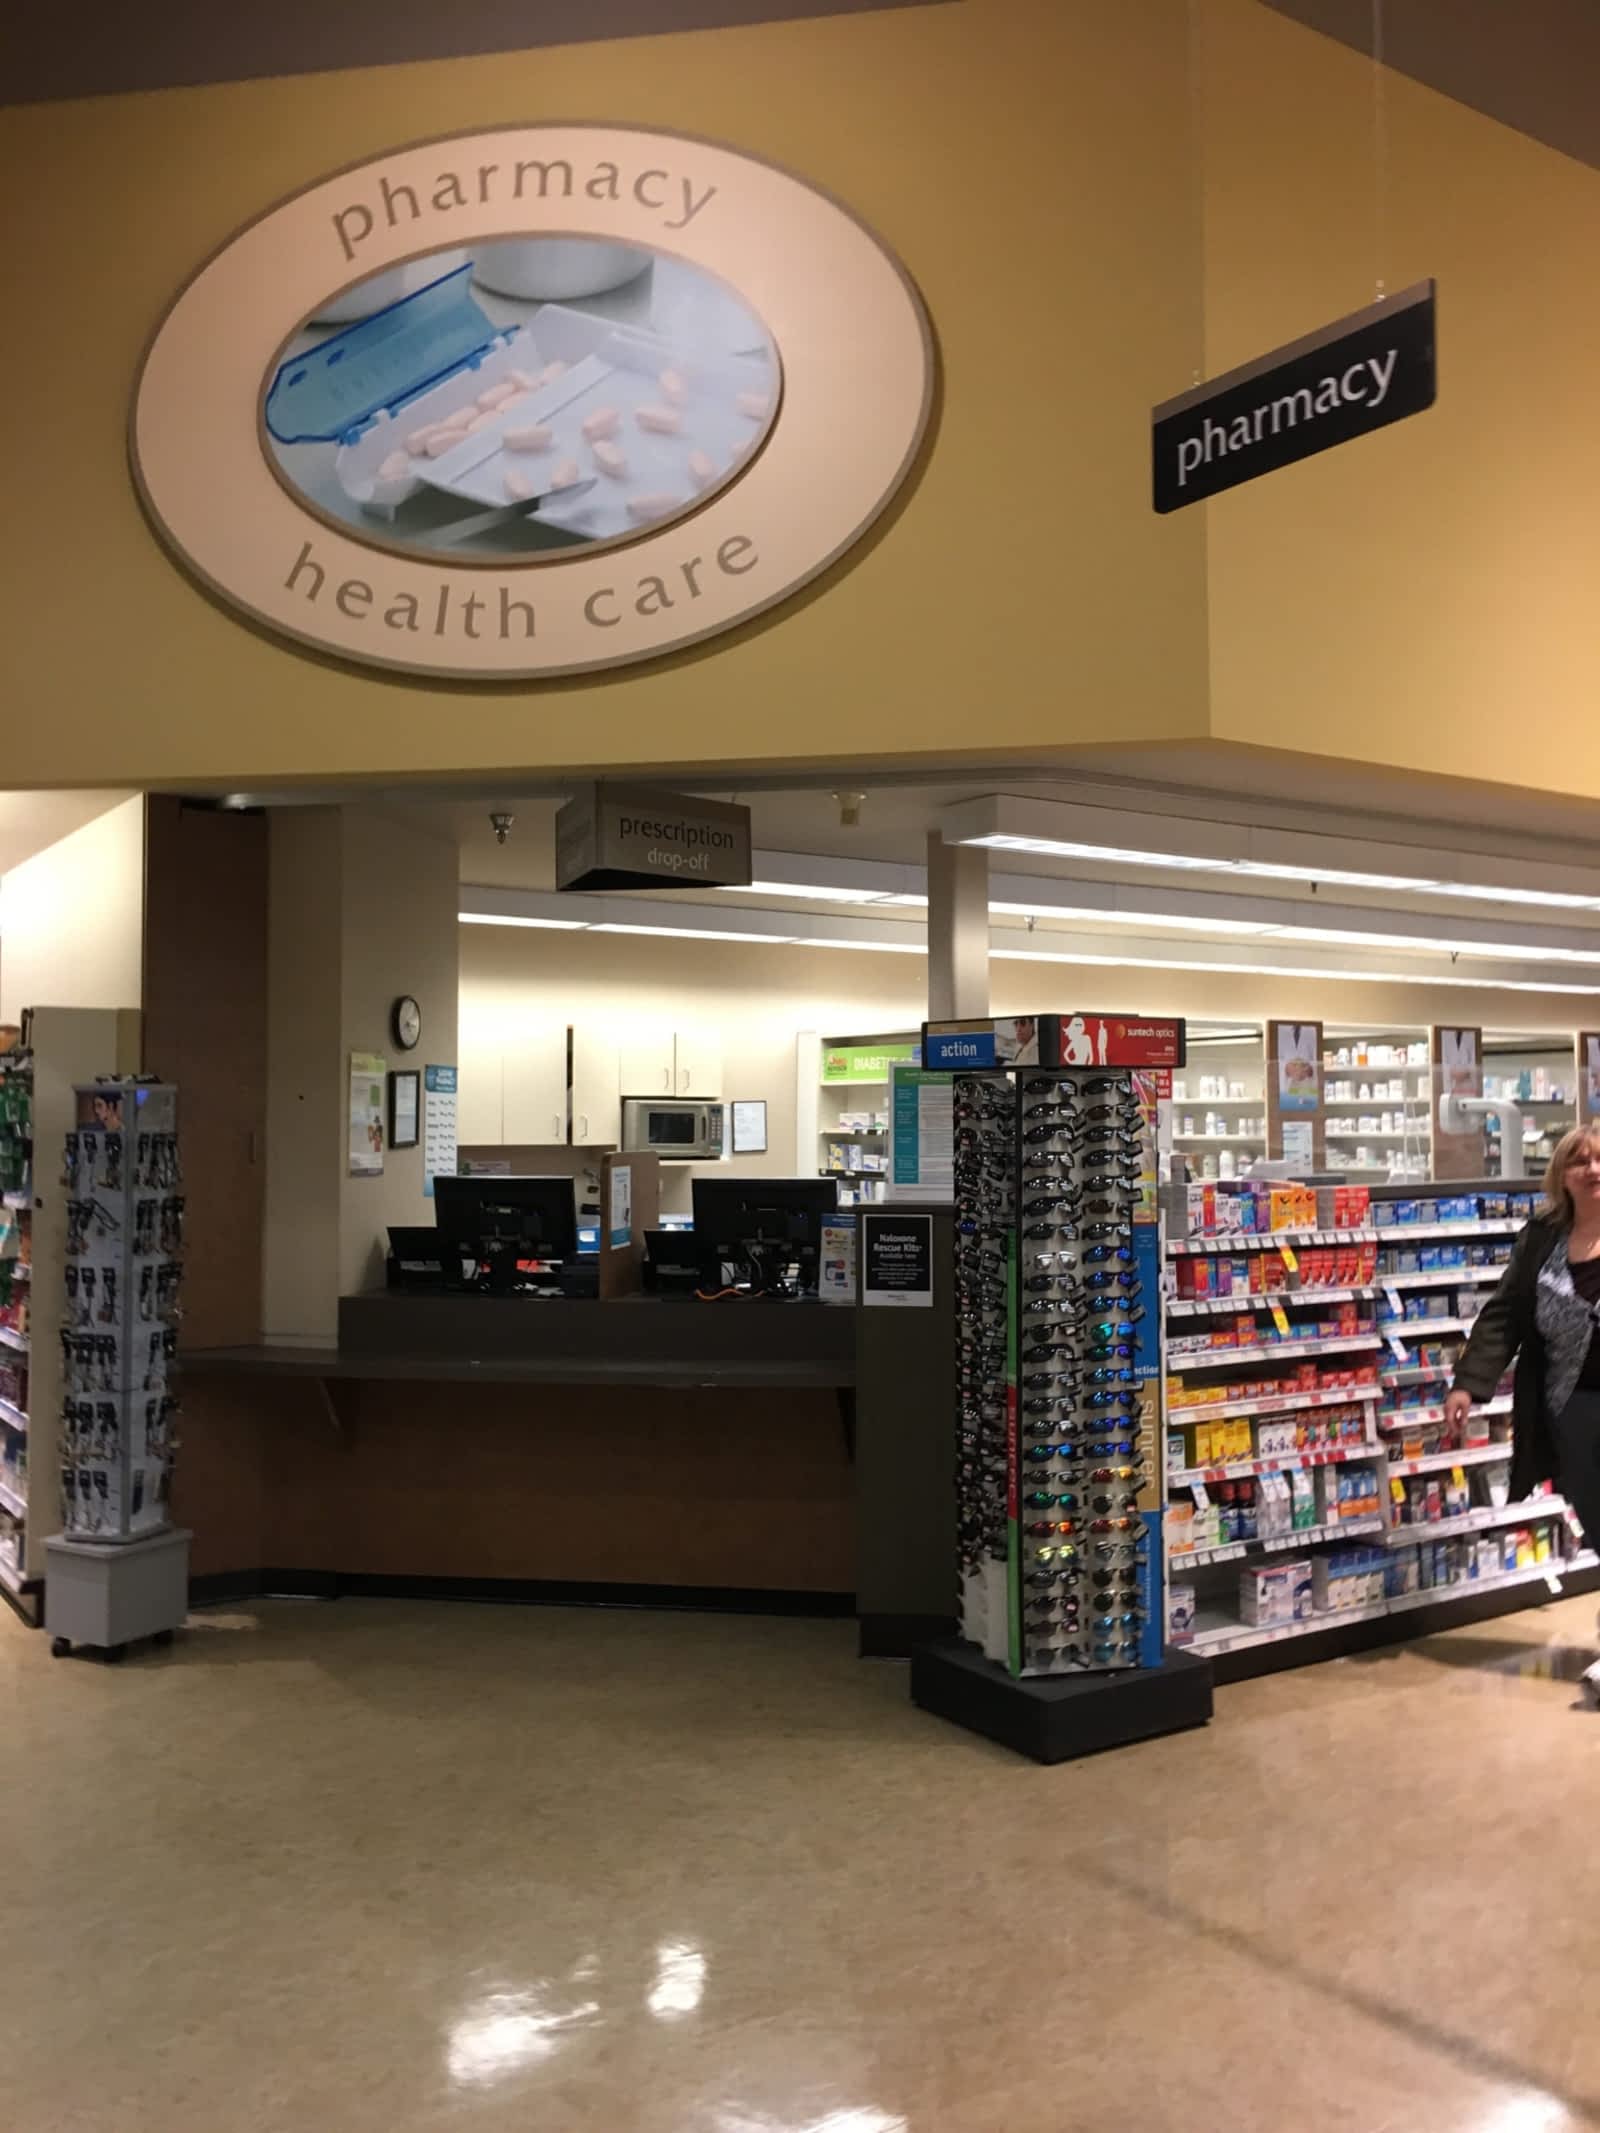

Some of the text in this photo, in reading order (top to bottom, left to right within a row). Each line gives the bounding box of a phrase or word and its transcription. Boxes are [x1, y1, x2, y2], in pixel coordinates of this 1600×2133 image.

[330, 157, 718, 258] pharmacy
[1177, 349, 1398, 486] pharmacy
[283, 533, 760, 639] health care
[619, 816, 734, 849] prescription
[647, 848, 710, 871] drop-off
[1127, 1026, 1175, 1039] suntech optics
[940, 1041, 977, 1057] action
[873, 1243, 901, 1252] Rescue
